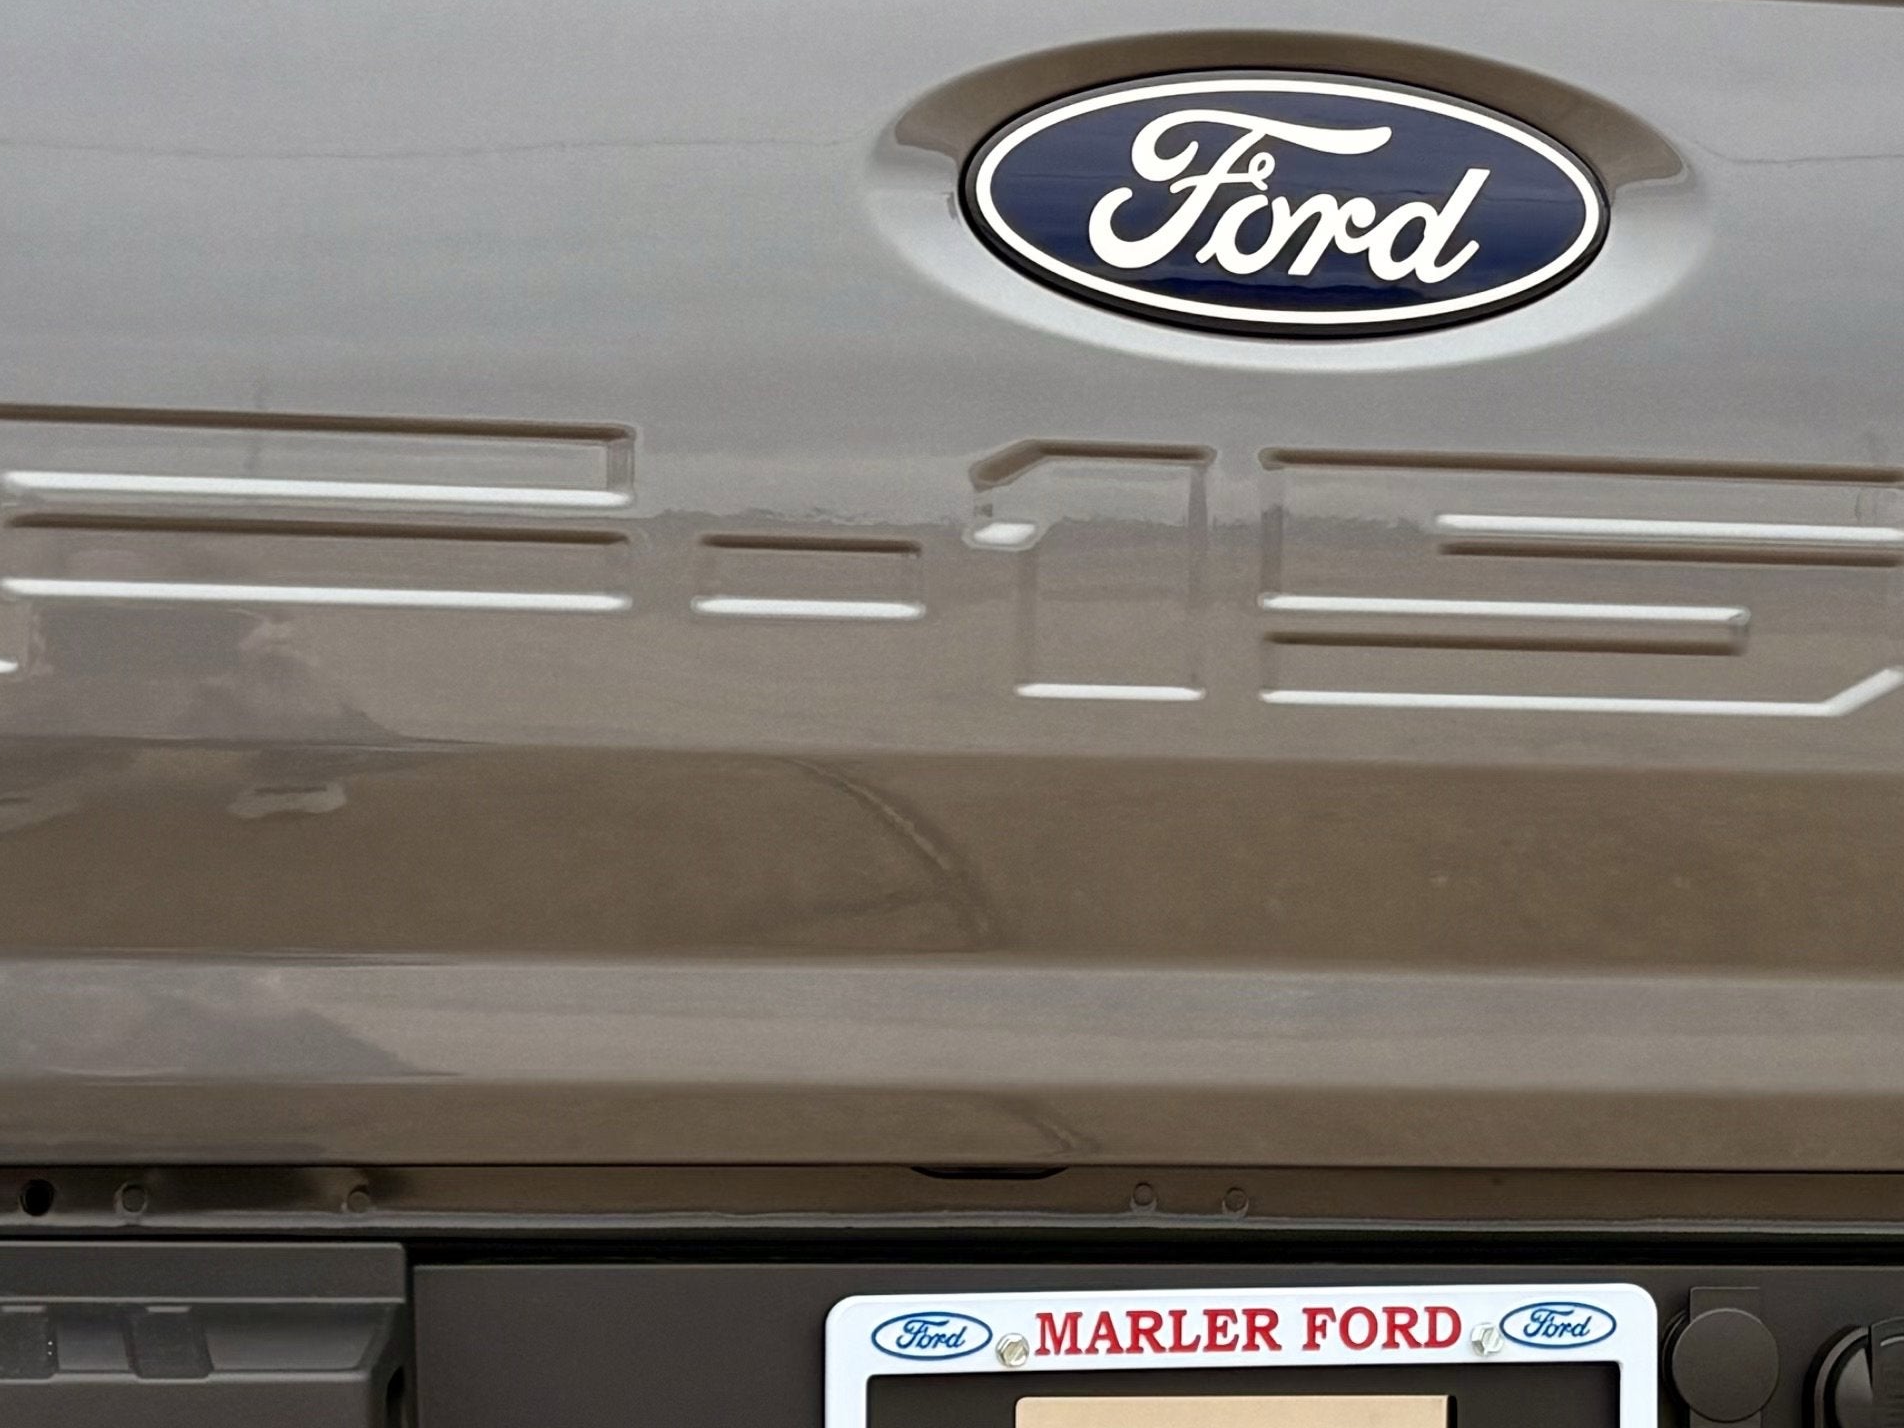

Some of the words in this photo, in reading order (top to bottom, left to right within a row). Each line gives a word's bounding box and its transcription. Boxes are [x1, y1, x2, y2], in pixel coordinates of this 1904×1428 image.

[1087, 108, 1491, 284] Ford
[895, 1318, 966, 1350] Ford
[1034, 1308, 1282, 1356] MARLER
[1302, 1305, 1463, 1351] FORD
[1523, 1307, 1592, 1338] Ford
